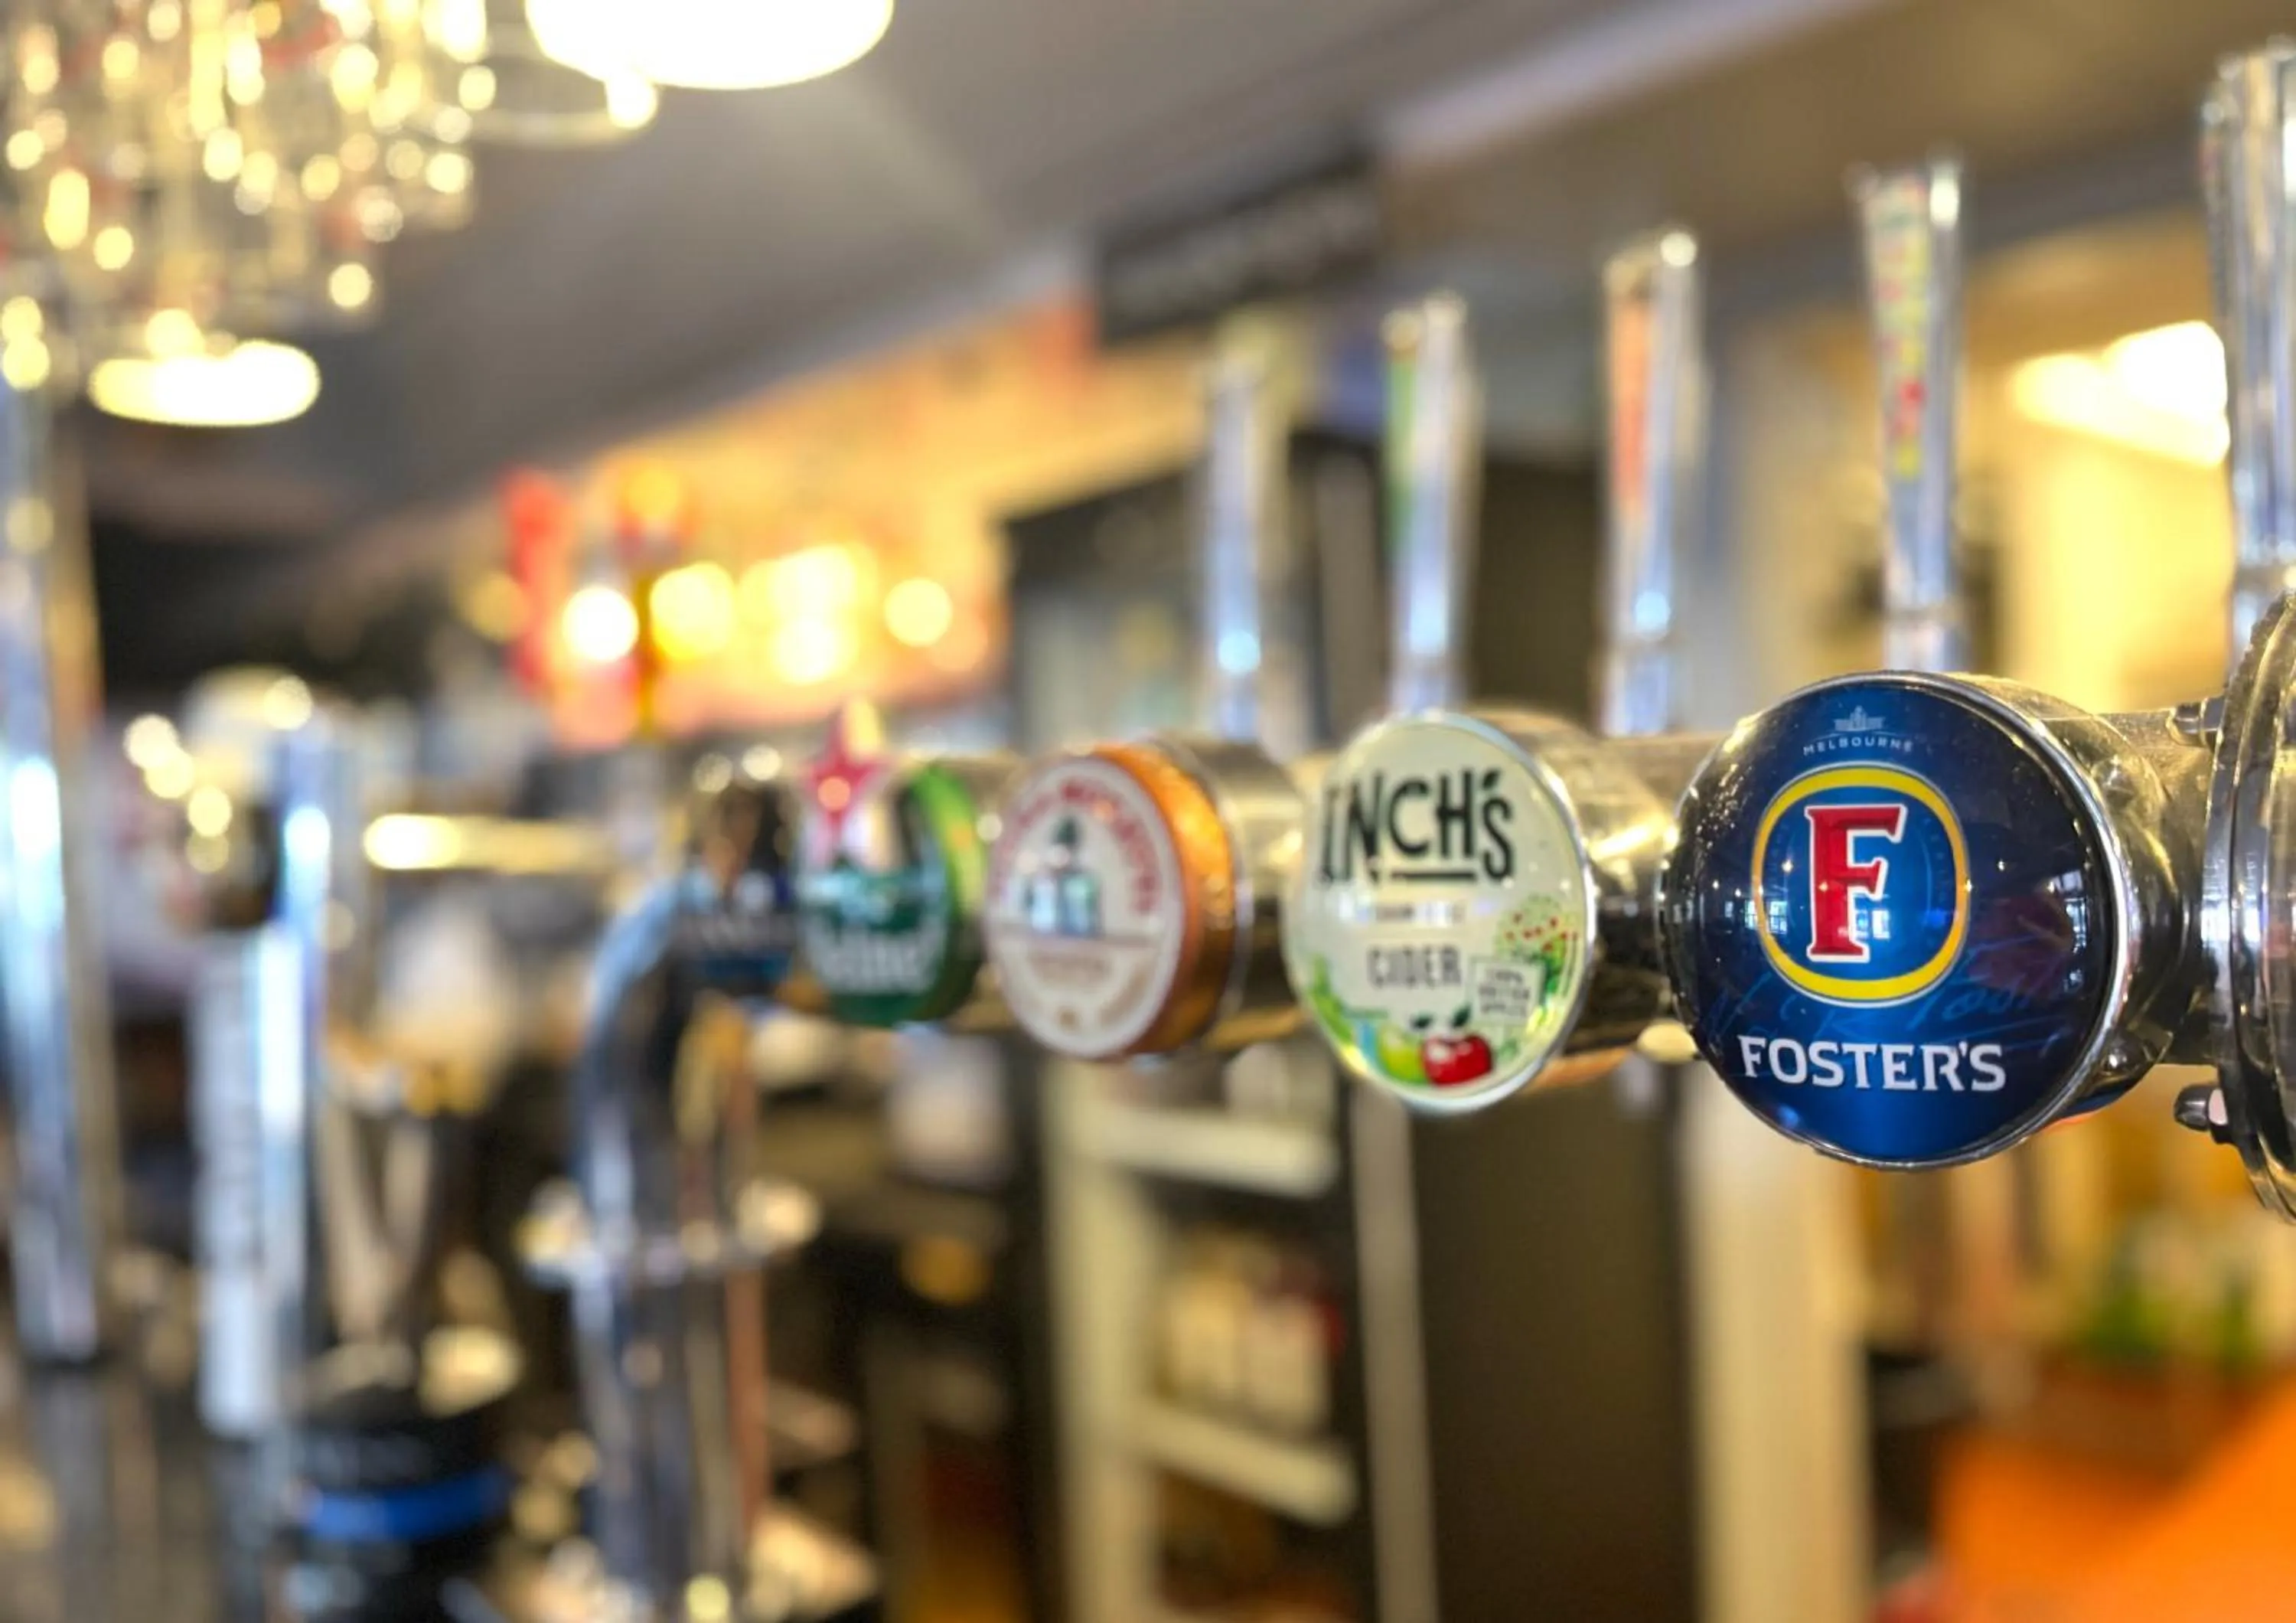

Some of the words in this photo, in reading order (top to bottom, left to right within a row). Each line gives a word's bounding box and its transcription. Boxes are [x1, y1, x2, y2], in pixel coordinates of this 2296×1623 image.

[1803, 736, 1913, 756] MELBOURNE
[1805, 804, 1908, 964] F
[1368, 945, 1462, 988] CIDER
[1737, 1035, 2007, 1092] FOSTER'S
